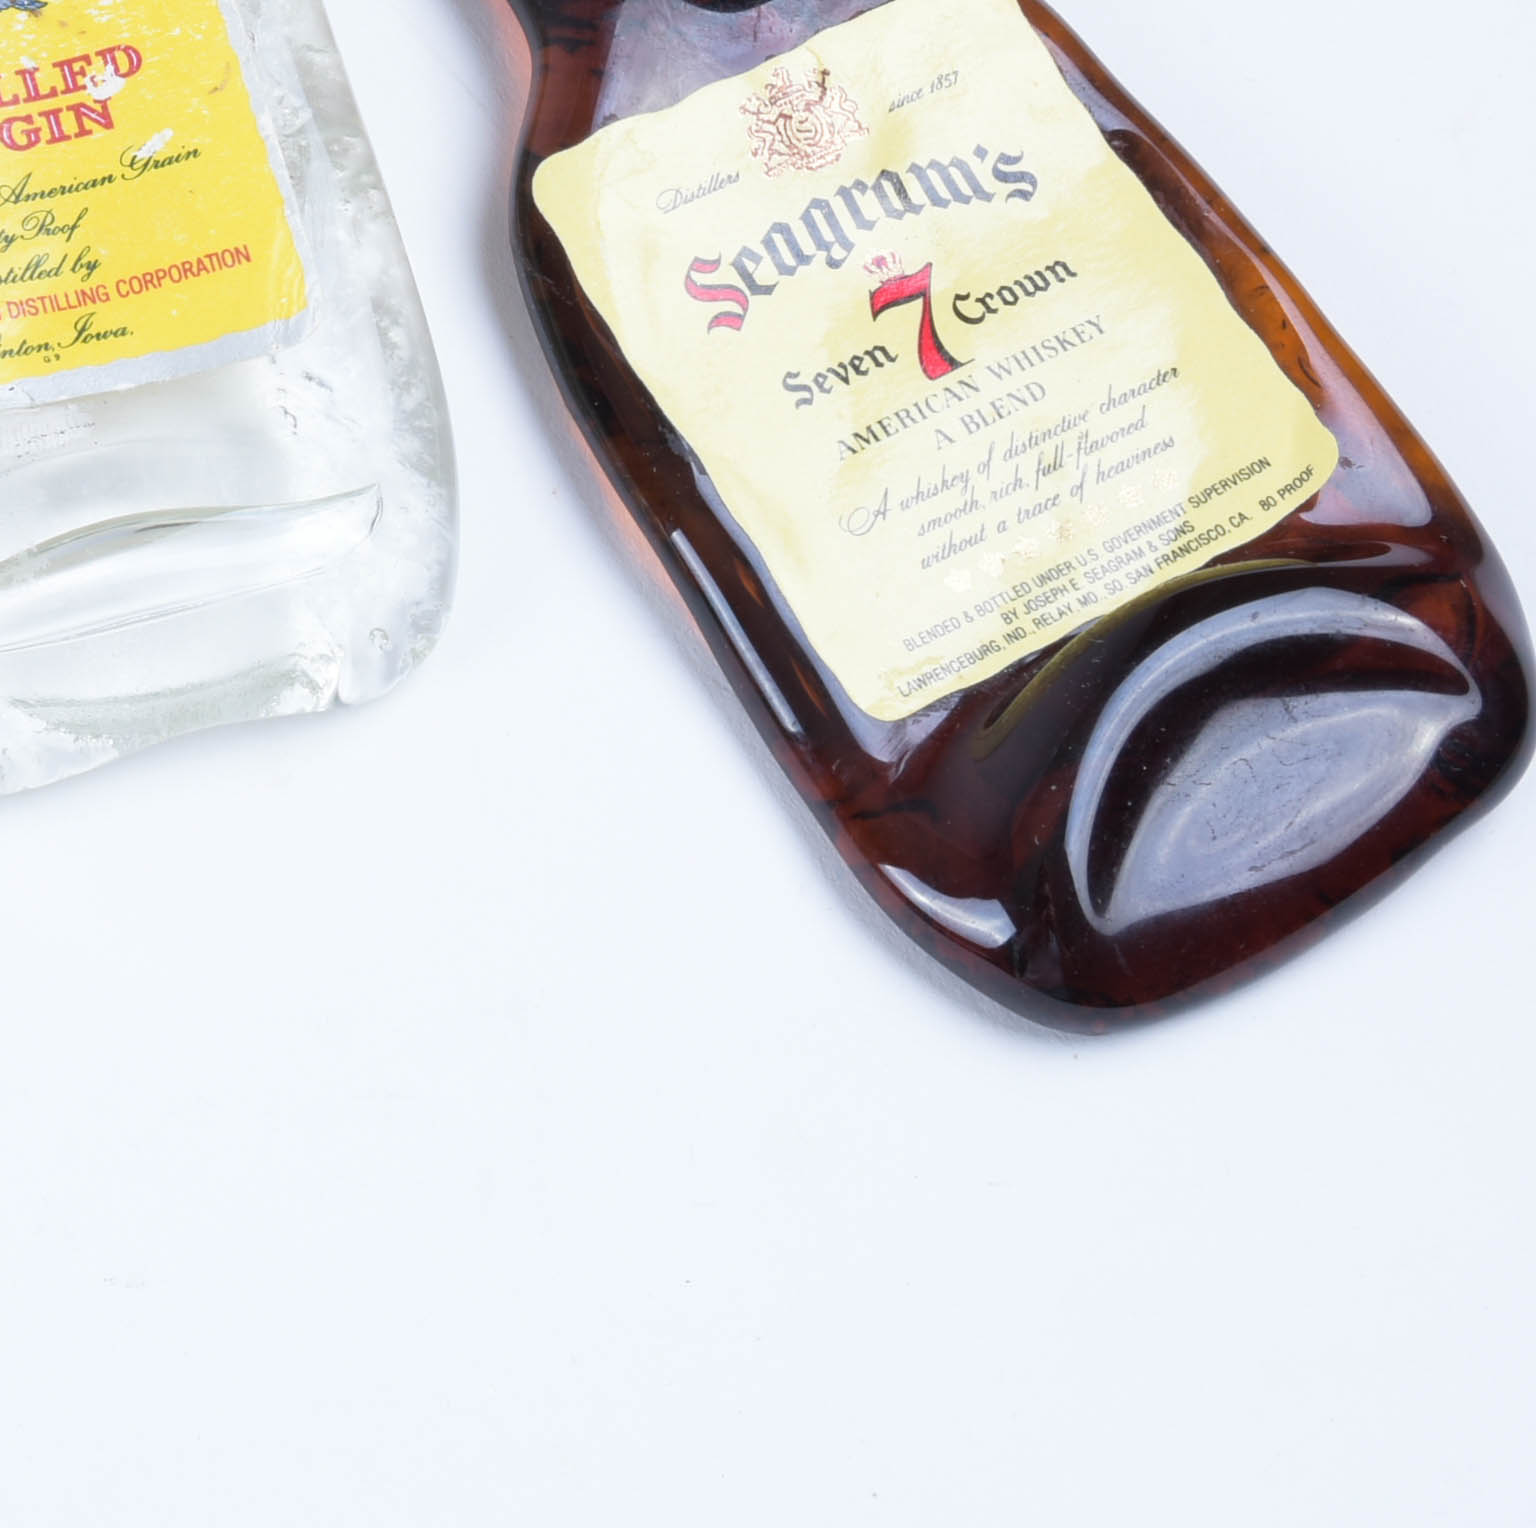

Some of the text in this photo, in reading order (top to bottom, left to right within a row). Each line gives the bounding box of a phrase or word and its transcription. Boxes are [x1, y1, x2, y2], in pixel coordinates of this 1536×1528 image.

[119, 142, 202, 181] Grain
[656, 169, 741, 215] Distillers
[887, 87, 924, 114] since
[5, 283, 112, 320] DISTILLING
[115, 244, 252, 299] CORPORATION
[19, 206, 89, 243] Proof
[69, 245, 102, 283] by
[686, 143, 1038, 332] Seagram's
[56, 311, 129, 349] Iowa.
[782, 260, 1078, 409] Seven 7 Crown
[837, 314, 1105, 456] AMERICAN WHISKEY
[899, 463, 976, 512] whiskey
[976, 440, 1007, 481] of
[1002, 409, 1089, 463] distinctive
[1099, 366, 1181, 415] character
[933, 381, 1047, 451] A BLEND
[902, 456, 1272, 653] BLENDED & BOTTLED UNDER GOVERNMENT SUPERVISION
[920, 435, 1175, 570] without a trace of heaviness
[1125, 563, 1156, 585] SAN
[1258, 495, 1278, 512] 80
[1276, 463, 1314, 501] PROOF
